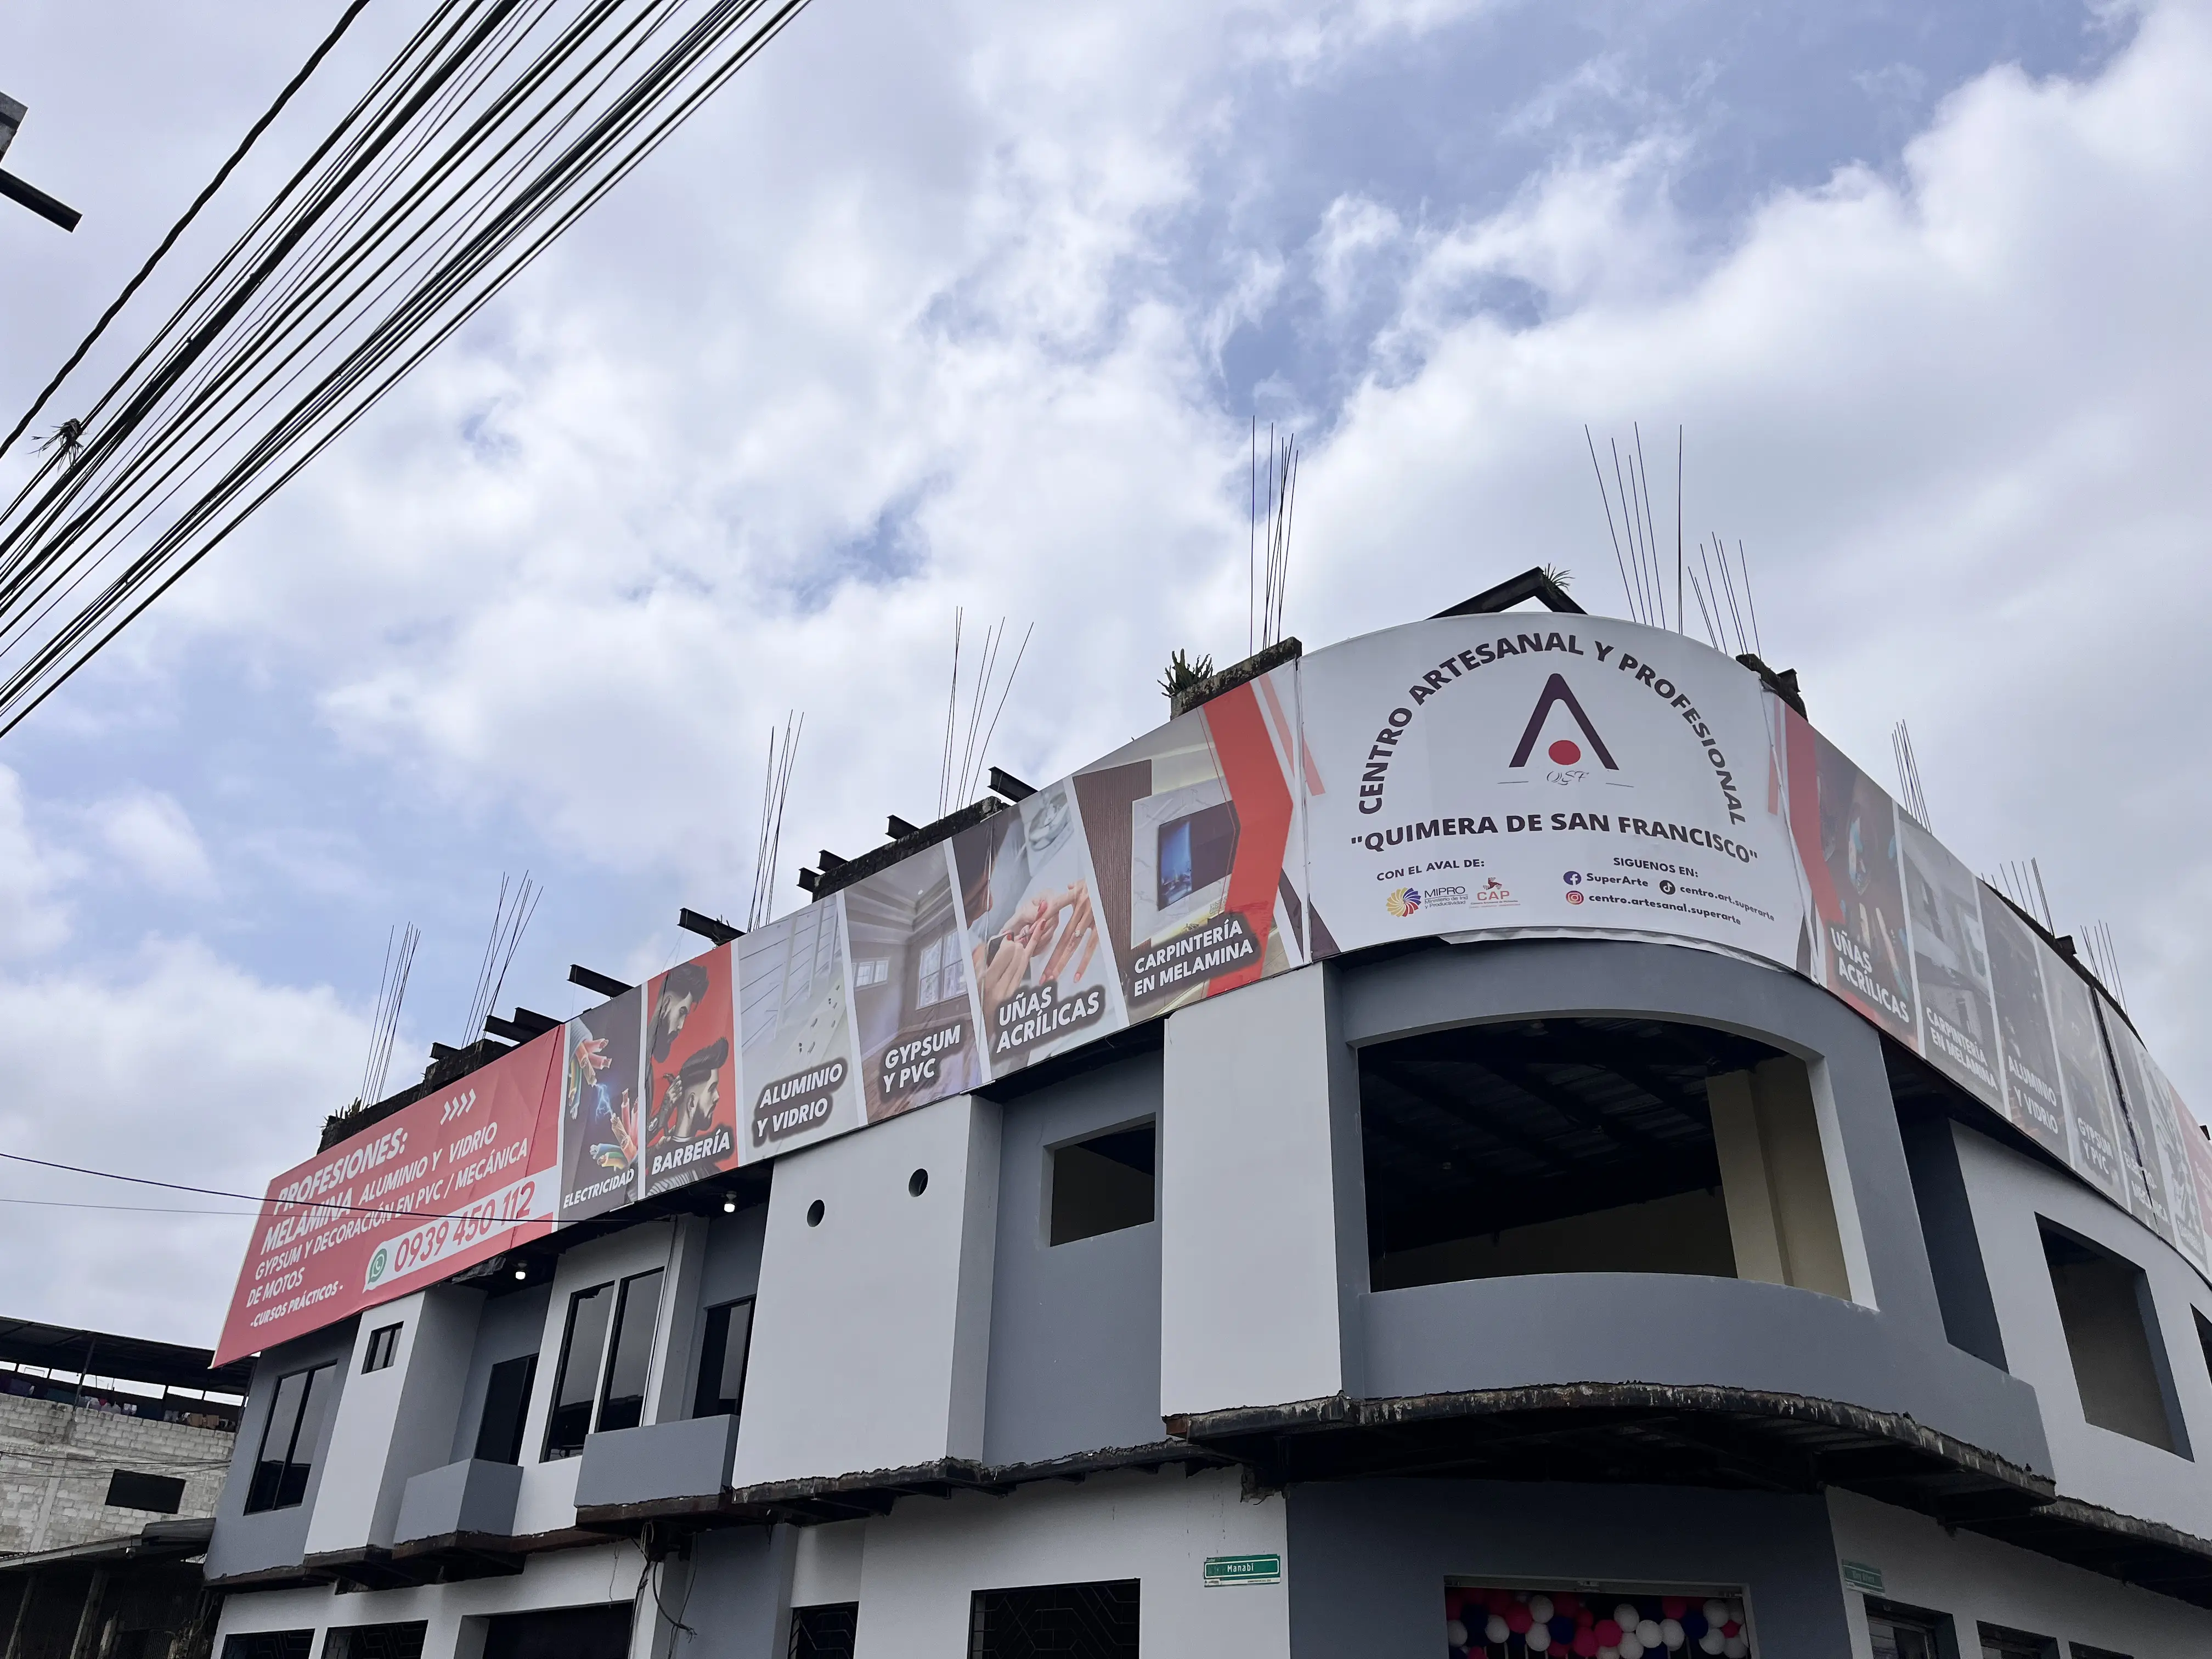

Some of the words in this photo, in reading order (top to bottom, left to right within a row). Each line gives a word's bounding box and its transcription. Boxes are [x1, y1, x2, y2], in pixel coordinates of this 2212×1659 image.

[1359, 708, 1412, 814] CENTRO
[1409, 633, 1583, 706] ARTESANAL
[1594, 641, 1615, 662] Y
[1618, 653, 1746, 825] PROFESIONAL
[1506, 814, 1543, 832] DE
[1550, 812, 1610, 832] SAN
[1376, 868, 1404, 881] CON
[1408, 865, 1422, 875] EL
[1426, 860, 1459, 871] AVAL
[1464, 859, 1485, 868] DE:
[1586, 873, 1649, 887] SuperArte
[1613, 857, 1675, 873] SIGUENOS
[1679, 866, 1698, 878] EN:
[1424, 886, 1465, 899] MIPRO
[1477, 890, 1510, 901] CAP
[1589, 894, 1741, 926] centro.artesanal.superarte
[1680, 885, 1775, 922] centro.art.superarte
[1134, 975, 1155, 997] EN
[1160, 939, 1253, 987] MELAMINA
[1135, 919, 1243, 974] CARPINTERÍA
[1831, 927, 1872, 973] UÑAS
[998, 986, 1052, 1026] UÑAS
[1838, 957, 1909, 1023] ACRÍLICAS
[996, 991, 1099, 1054] ACRÍLICAS
[1926, 1007, 1988, 1067] CARPINTERÍA
[885, 1024, 961, 1069] GYPSUM
[1929, 1027, 1946, 1052] EN
[1948, 1040, 1998, 1091] MELAMINA
[759, 1063, 843, 1109] ALUMINIO
[883, 1073, 896, 1093] Y
[899, 1058, 936, 1088] PVC
[2008, 1055, 2057, 1107] ALUMINIO
[757, 1118, 768, 1137] Y
[772, 1098, 828, 1132] VIDRIO
[2013, 1086, 2022, 1107] Y
[2023, 1093, 2058, 1135] VIDRIO
[273, 1127, 408, 1217] PROFESIONES:
[651, 1128, 730, 1175] BARBERÍA
[255, 1244, 303, 1281] GYPSUM
[304, 1238, 314, 1260] Y
[313, 1203, 395, 1255] DECORACIÓN
[394, 1193, 414, 1218] EN
[415, 1179, 444, 1210] PVC
[455, 1137, 528, 1191] MECÁNICA
[260, 1187, 352, 1256] MELAMINA
[358, 1156, 428, 1206] ALUMINIO
[431, 1148, 442, 1171] Y
[449, 1122, 498, 1164] VIDRIO
[563, 1168, 634, 1209] ELECTRICIDAD
[394, 1221, 449, 1272] 0939
[453, 1199, 495, 1246] 450
[501, 1181, 535, 1226] 112
[246, 1287, 266, 1308] DE
[264, 1267, 304, 1299] MOTOS
